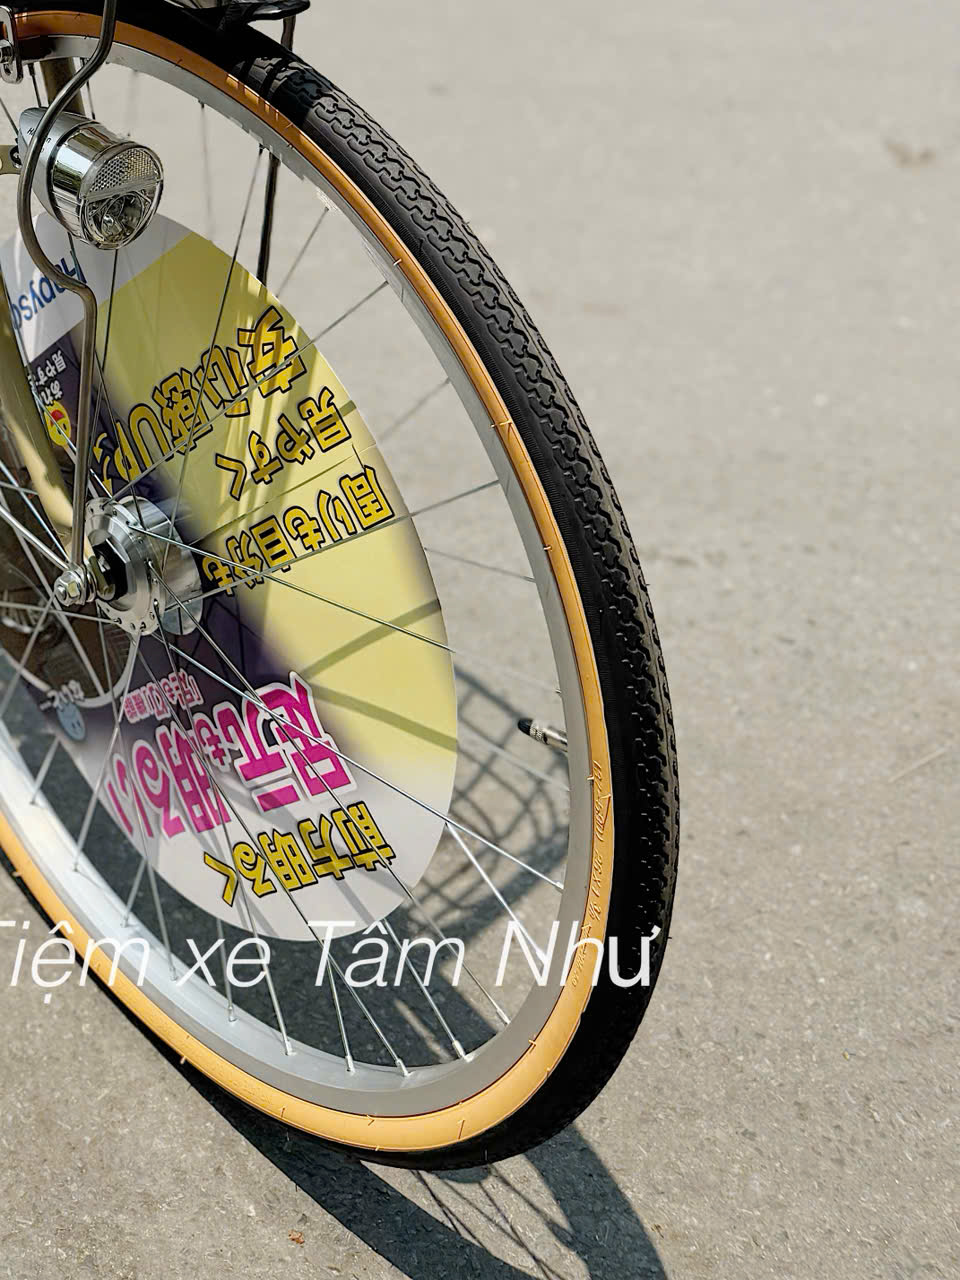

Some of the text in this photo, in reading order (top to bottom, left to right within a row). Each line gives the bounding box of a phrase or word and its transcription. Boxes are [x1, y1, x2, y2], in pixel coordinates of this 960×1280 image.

[215, 387, 352, 502] 見やすく
[201, 465, 395, 597] 周りも自分も
[102, 671, 357, 838] 足元も明るい
[203, 801, 396, 908] 前方明るく
